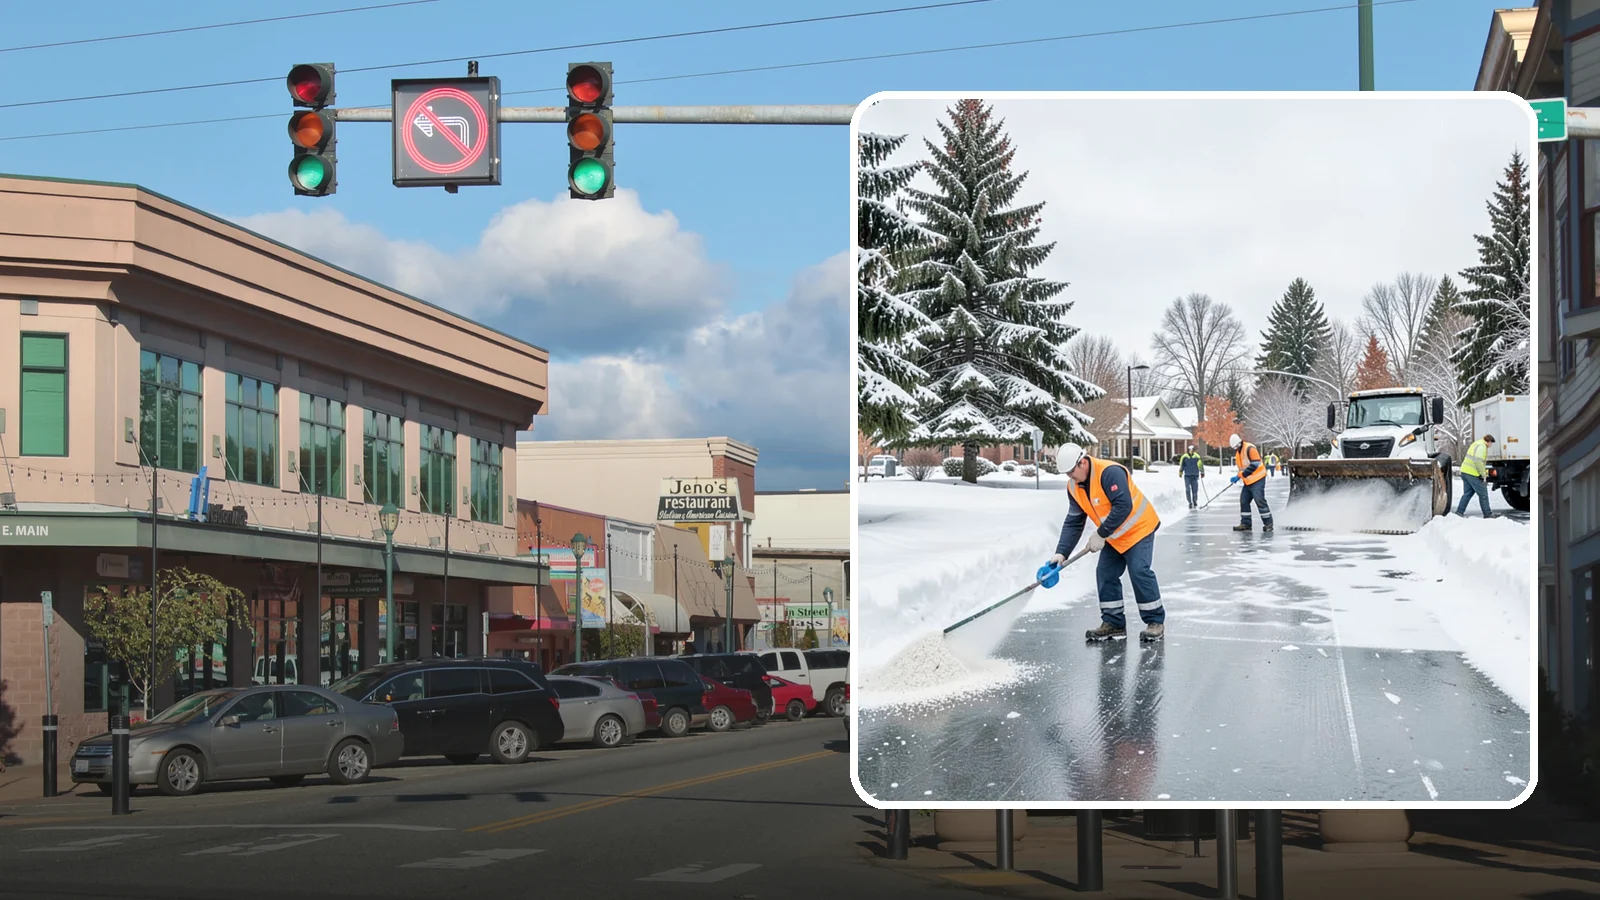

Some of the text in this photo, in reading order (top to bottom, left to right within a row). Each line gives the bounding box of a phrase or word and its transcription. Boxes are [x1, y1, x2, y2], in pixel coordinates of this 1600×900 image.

[670, 480, 727, 494] Jeno's
[665, 497, 731, 509] restaurant
[659, 510, 681, 519] Italian
[686, 510, 714, 519] American
[715, 510, 737, 519] Cuisine
[2, 525, 49, 536] E. MAIN
[798, 608, 828, 616] Street
